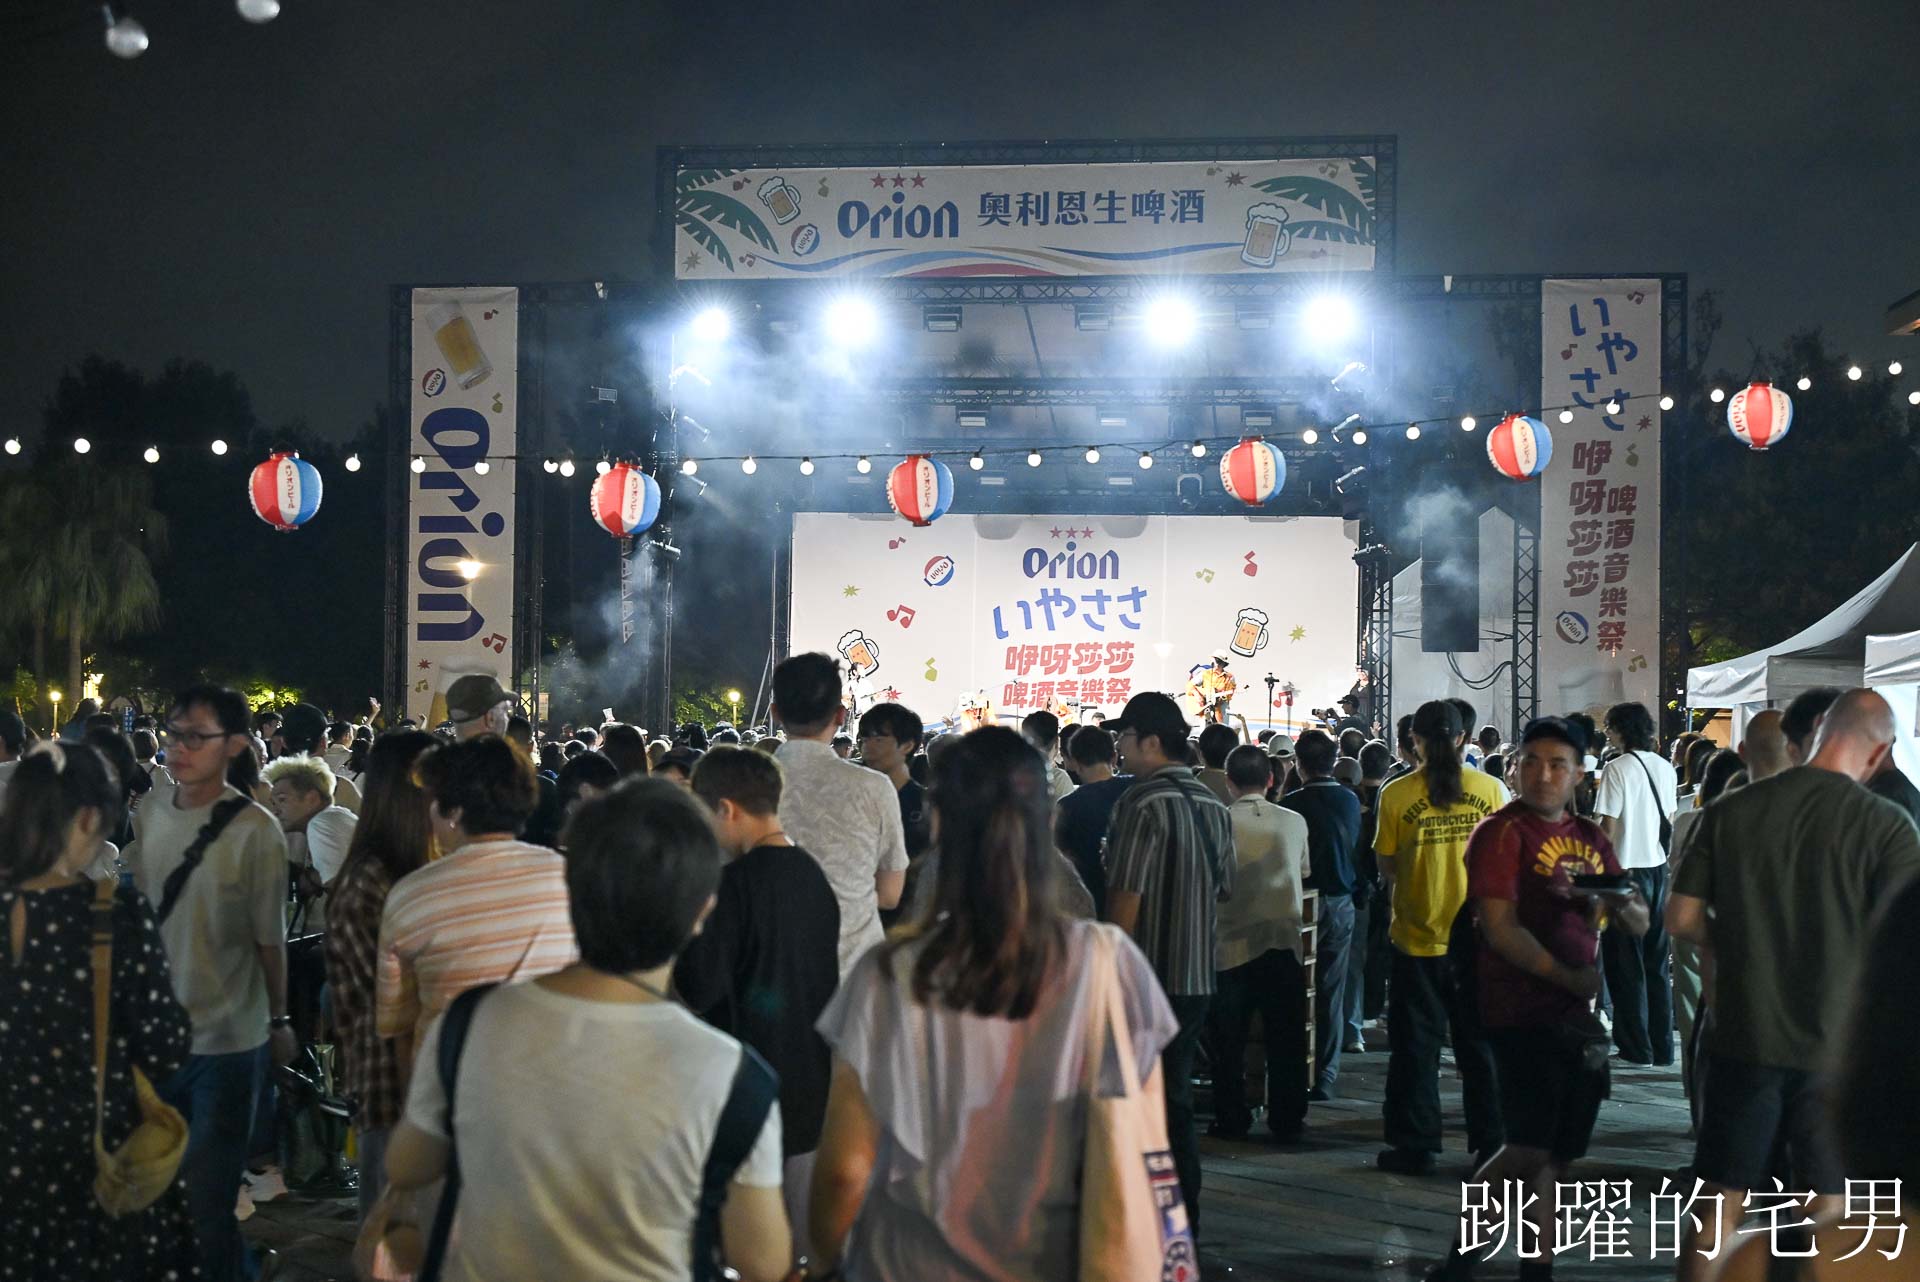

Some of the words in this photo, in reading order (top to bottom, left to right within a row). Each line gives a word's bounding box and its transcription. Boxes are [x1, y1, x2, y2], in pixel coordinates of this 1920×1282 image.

[837, 191, 959, 239] Orion
[977, 190, 1205, 228] 奧利恩生啤酒
[417, 407, 505, 641] Orion
[1563, 440, 1612, 598] 咿呀莎莎
[1022, 541, 1120, 580] Orion
[1596, 484, 1638, 652] 啤酒音樂祭
[993, 586, 1148, 640] いやささ
[1005, 641, 1135, 676] 咿呀莎莎
[1403, 798, 1429, 825] DEUS
[1418, 812, 1481, 828] MOTORCYCLES
